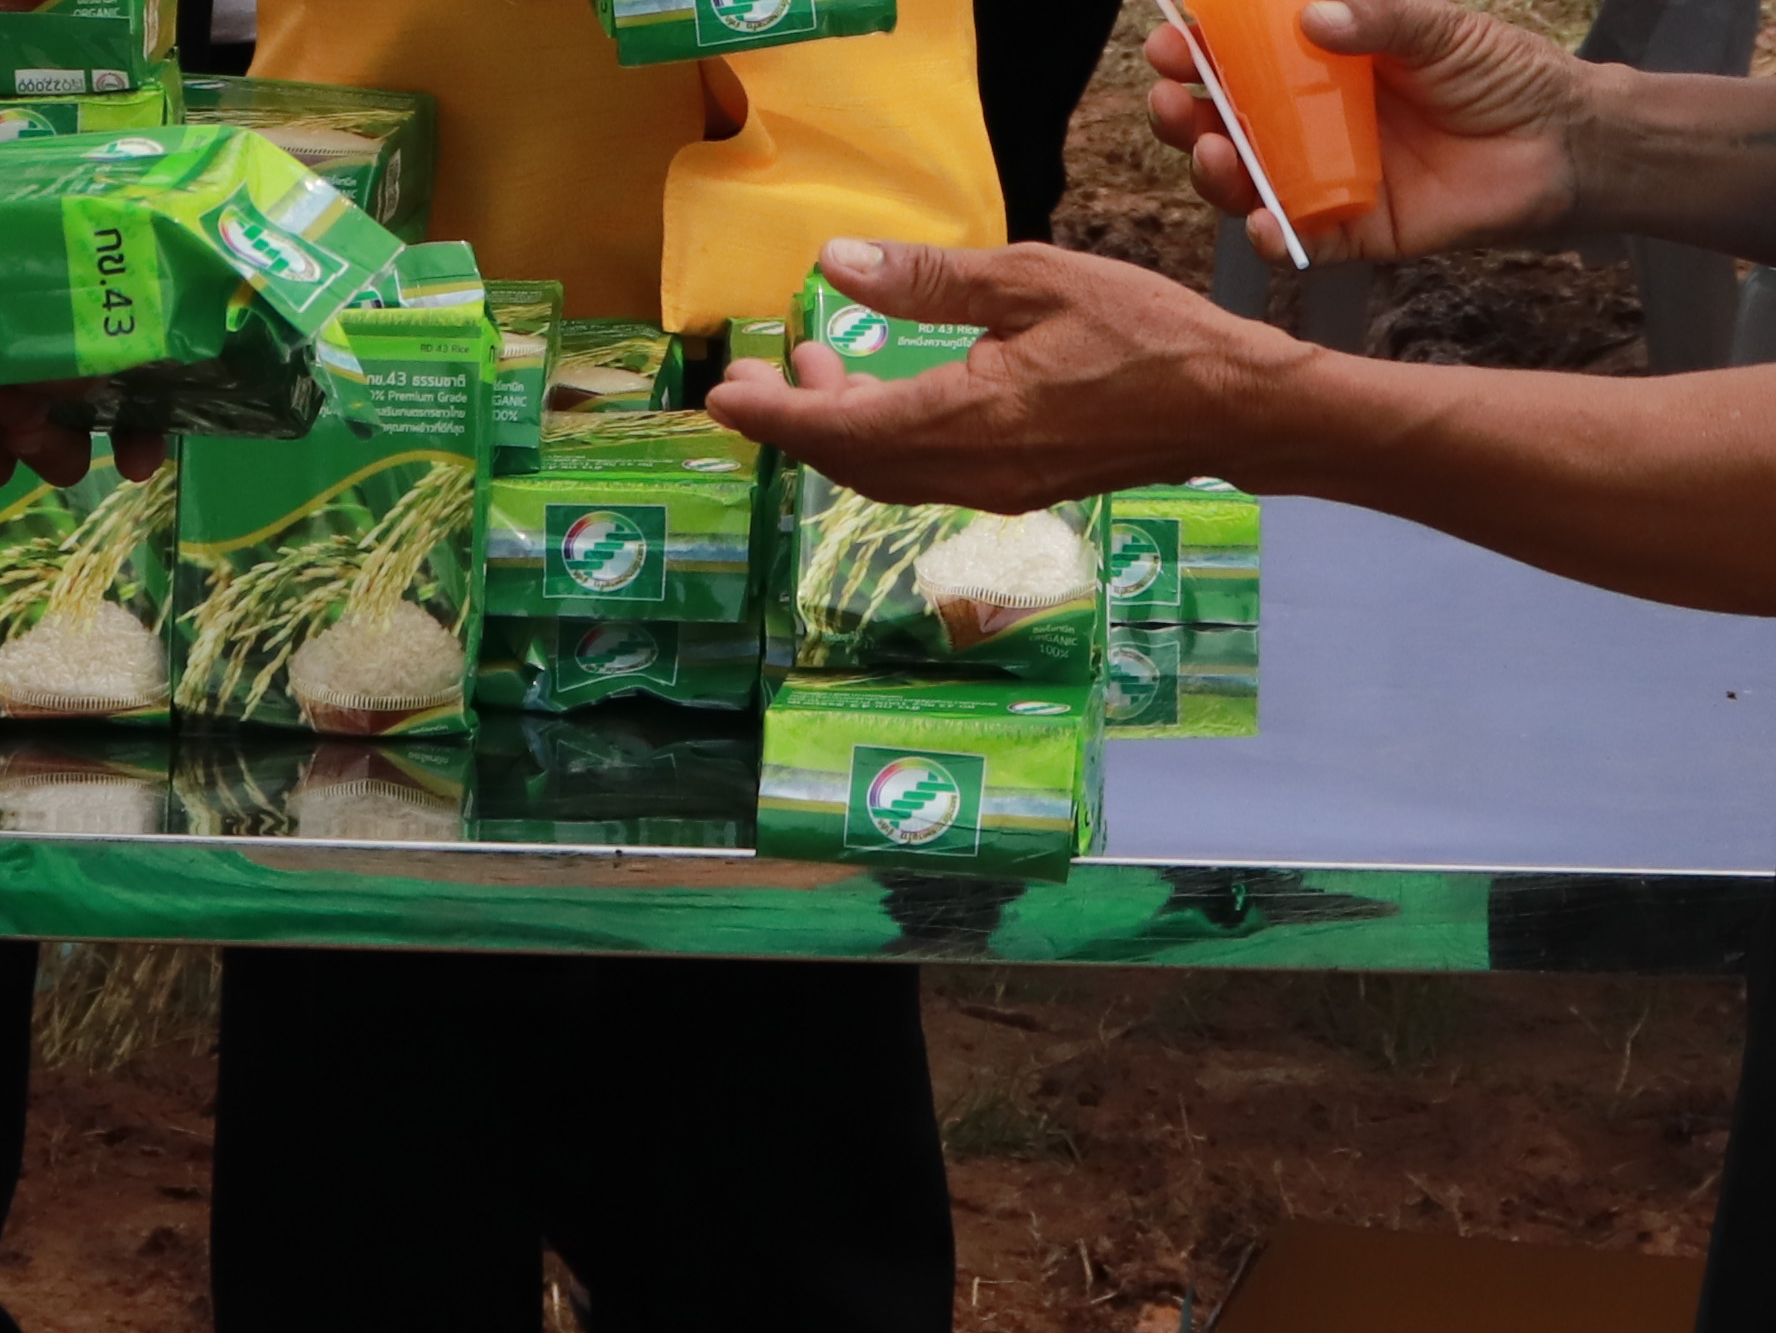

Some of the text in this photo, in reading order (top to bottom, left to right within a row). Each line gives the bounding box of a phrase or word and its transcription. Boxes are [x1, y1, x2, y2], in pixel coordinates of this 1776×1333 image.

[92, 227, 136, 338] กข.43
[918, 324, 980, 335] RD 43 Rice
[419, 343, 471, 354] RD 43 Rice
[411, 372, 467, 388] ธรรมชาติ
[387, 390, 434, 403] Premium
[437, 391, 468, 404] Grade
[1029, 634, 1079, 647] ORGANIC
[1040, 645, 1070, 659] 100%
